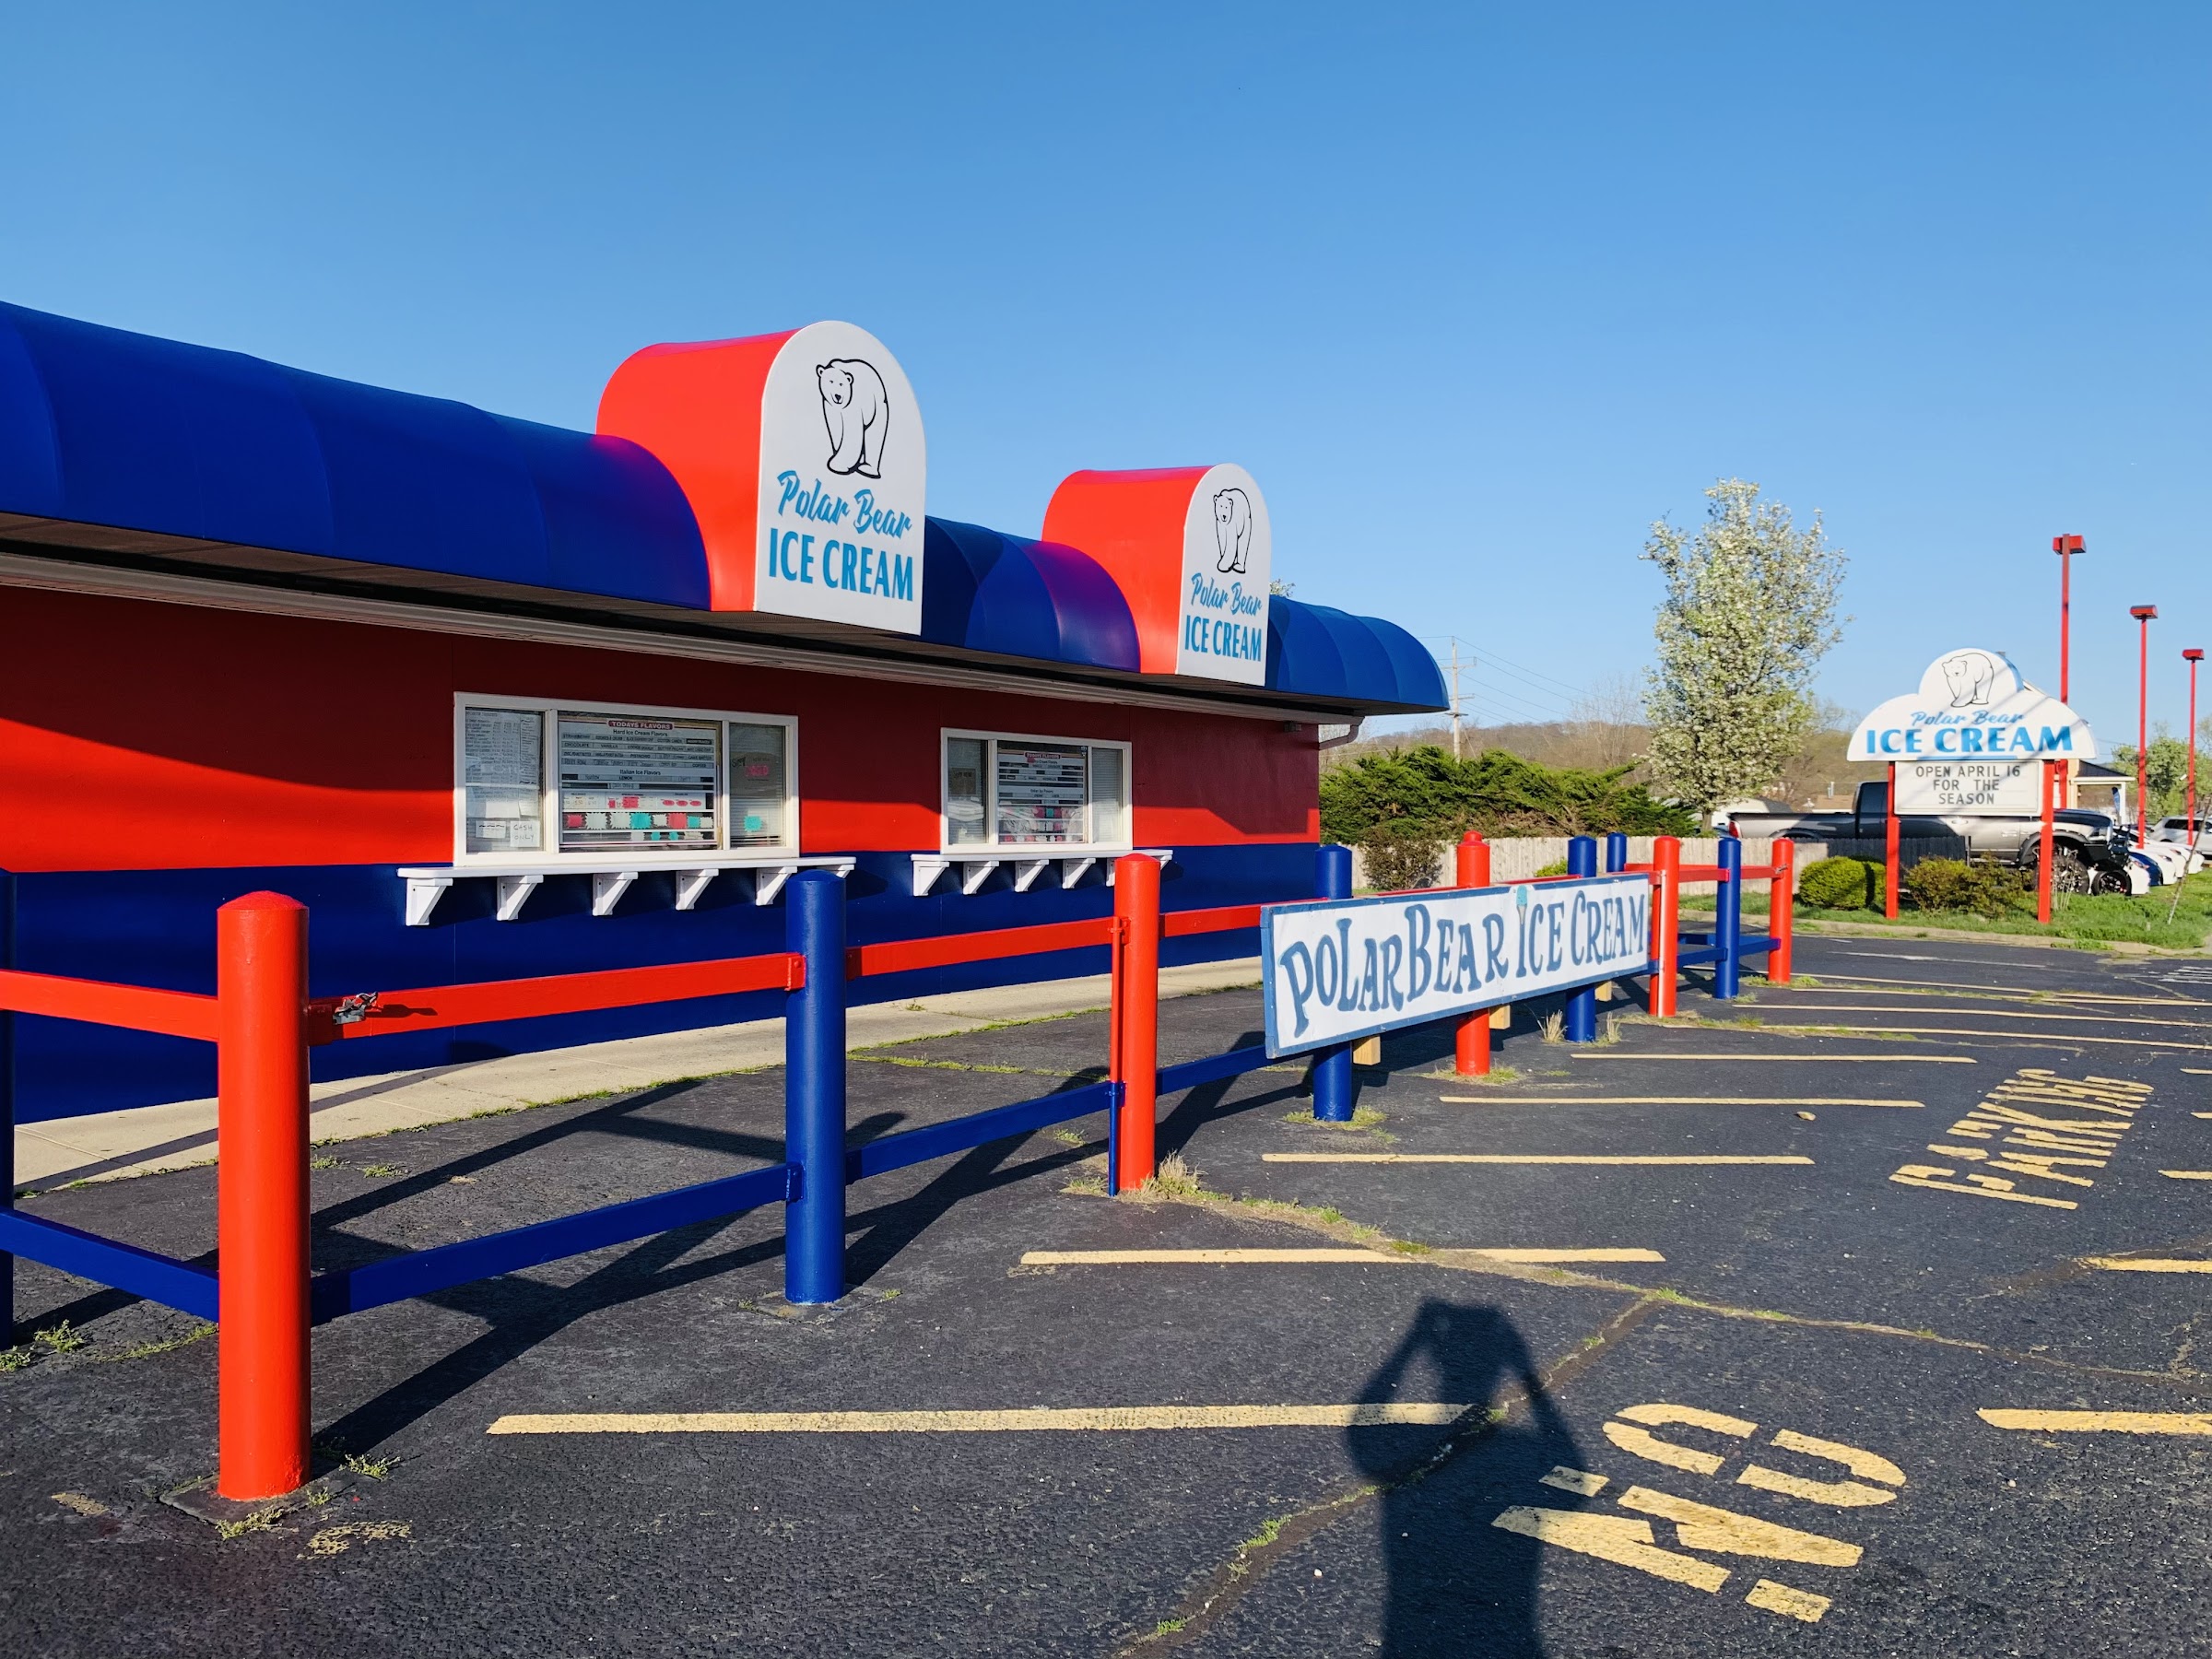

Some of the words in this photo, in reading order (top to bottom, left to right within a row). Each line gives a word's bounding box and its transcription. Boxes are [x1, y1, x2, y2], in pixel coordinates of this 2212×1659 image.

[777, 470, 850, 525] Polar
[853, 488, 912, 539] Bear
[769, 527, 815, 584] ICE
[822, 539, 913, 602] CREAM
[1191, 572, 1229, 609] Polar
[1230, 582, 1262, 617] Bear
[1184, 615, 1209, 653] ICE
[1213, 620, 1262, 662] CREAM
[1911, 711, 1967, 726] Polar
[1971, 710, 2024, 725] Bear
[1866, 728, 1922, 754] ICE
[1934, 725, 2073, 753] CREAM
[1915, 766, 1951, 778] OPEN
[1958, 765, 2000, 777] APRIL
[2006, 765, 2021, 777] 16
[1933, 779, 1959, 791] FOR
[1973, 779, 2000, 791] THE
[1938, 793, 1994, 805] SEASON
[514, 835, 535, 844] ONLY
[1278, 917, 1404, 1039] POLAR
[1405, 903, 1509, 1003] BEAR
[1515, 884, 1565, 979] ICE
[1571, 889, 1646, 967] CREAM
[1490, 1403, 1907, 1624] NO
[1889, 1067, 2155, 1211] PARKING
